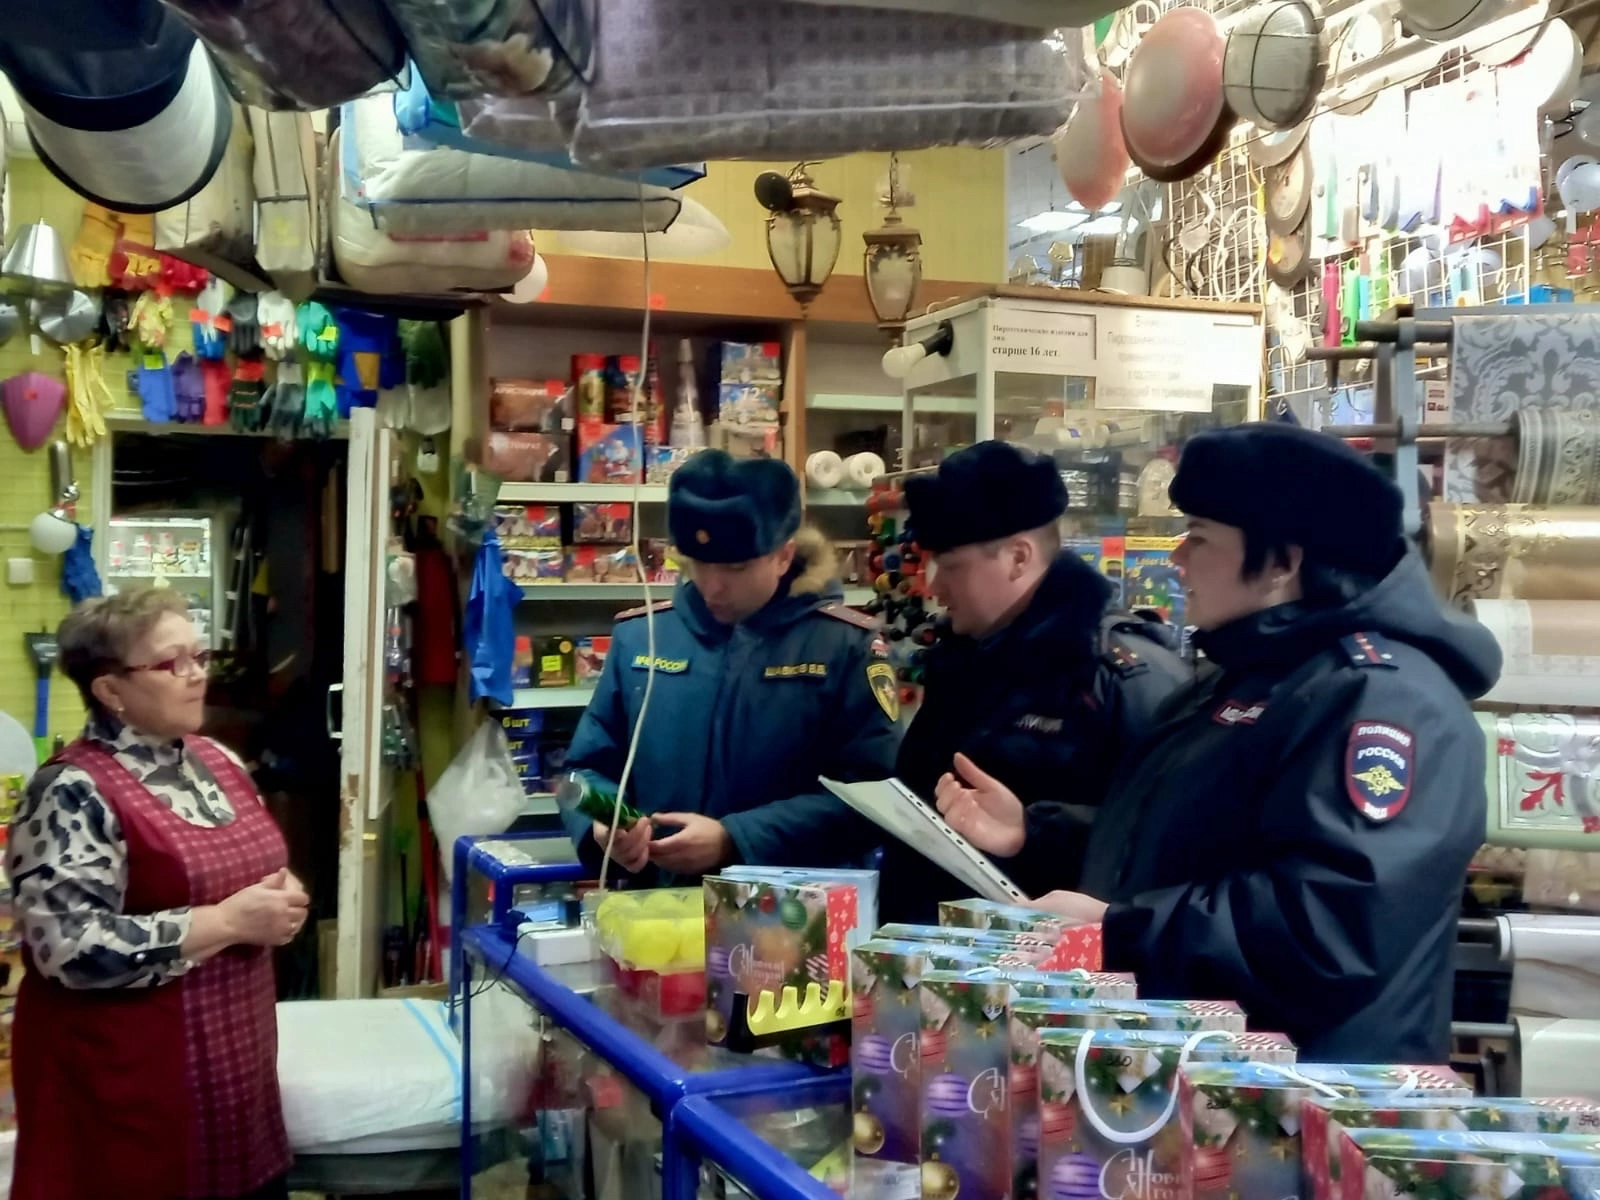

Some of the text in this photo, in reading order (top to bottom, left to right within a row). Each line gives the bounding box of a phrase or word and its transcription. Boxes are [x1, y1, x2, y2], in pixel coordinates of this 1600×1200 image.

[992, 346, 1028, 357] старше
[1030, 345, 1041, 356] 16
[1357, 724, 1412, 748] ПОЛИЦИЯ
[1356, 746, 1407, 771] РОССИЯ
